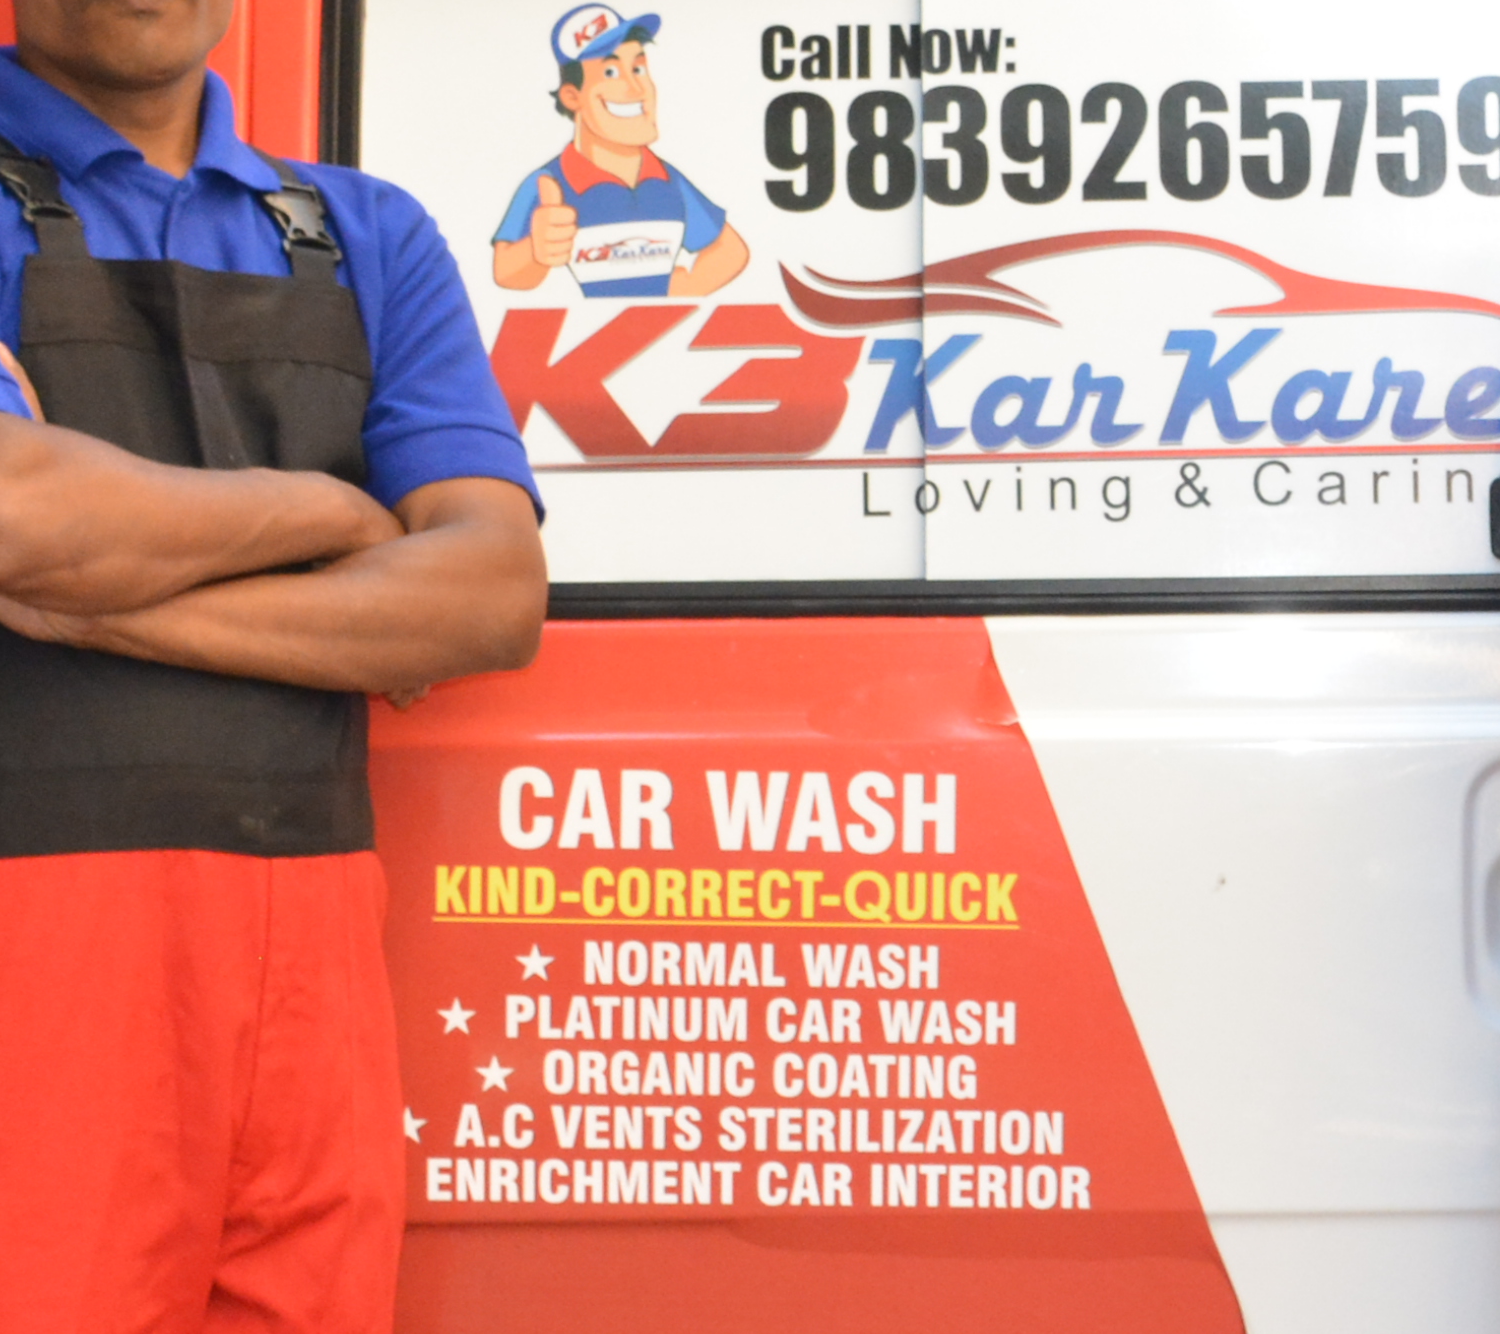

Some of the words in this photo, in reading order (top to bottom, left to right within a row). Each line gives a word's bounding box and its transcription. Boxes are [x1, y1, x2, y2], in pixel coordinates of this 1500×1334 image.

[573, 13, 608, 48] K3
[760, 24, 871, 82] Call
[889, 24, 1017, 80] Now:
[488, 303, 867, 462] K3
[862, 333, 1145, 455] Kar
[860, 466, 1132, 522] Loving
[1174, 462, 1212, 509] &
[499, 766, 674, 851] CAR
[706, 769, 957, 855] WASH
[433, 865, 1019, 923] KIND-CORRECT-QUICK
[583, 940, 786, 988] NORMAL
[802, 944, 940, 989] WASH
[505, 995, 748, 1042] PLATINUM
[766, 998, 862, 1043] CAR
[880, 1000, 1017, 1046] WASH
[542, 1050, 756, 1097] ORGANIC
[772, 1053, 978, 1100] COATING
[454, 1104, 535, 1148] A.C
[551, 1106, 703, 1152] VENTS
[719, 1108, 1065, 1156] STERILIZATION
[426, 1158, 742, 1206] ENRICHMENT
[757, 1162, 853, 1207] CAR
[870, 1164, 1092, 1211] INTERIOR
